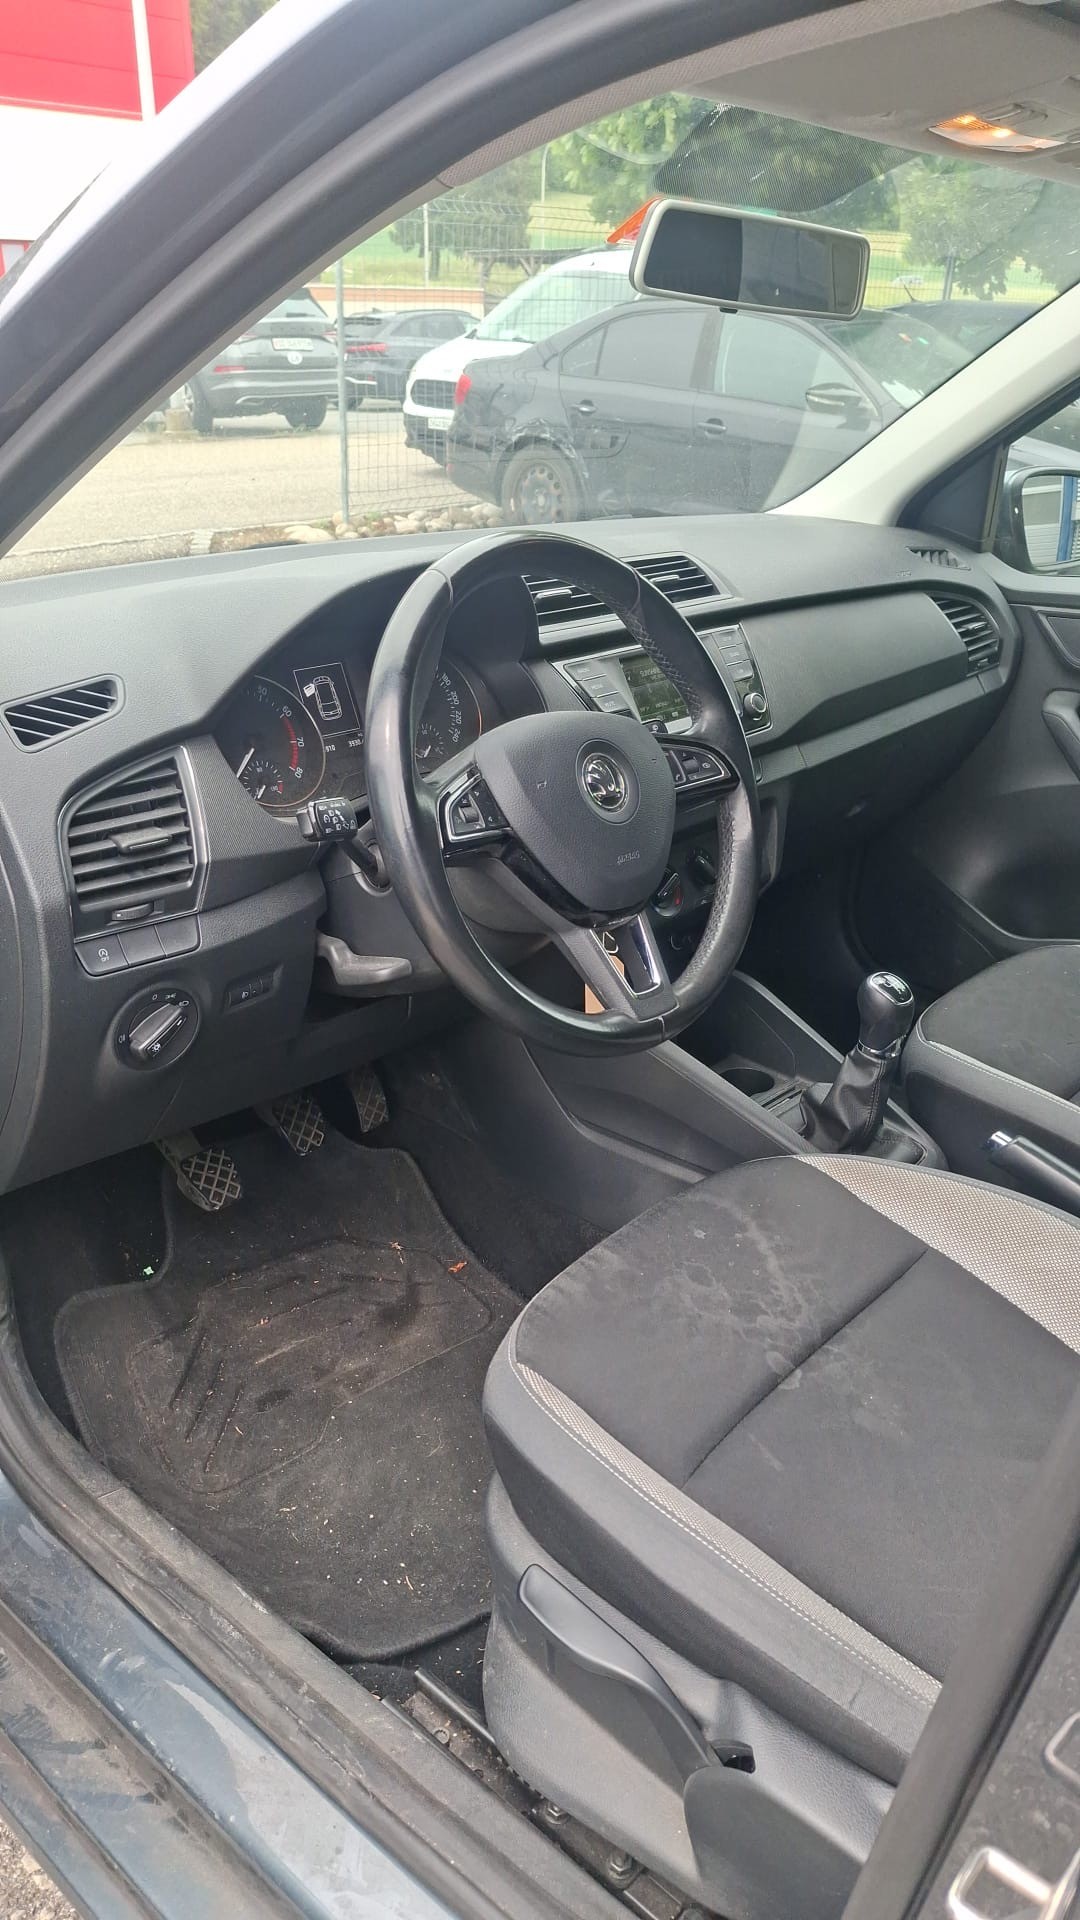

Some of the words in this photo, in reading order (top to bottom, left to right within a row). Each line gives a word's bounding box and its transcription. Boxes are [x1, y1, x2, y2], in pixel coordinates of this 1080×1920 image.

[441, 673, 451, 686] 180
[450, 691, 459, 705] 200
[282, 705, 292, 717] 60
[452, 728, 461, 742] 240
[296, 736, 305, 747] 70
[294, 766, 304, 778] 80
